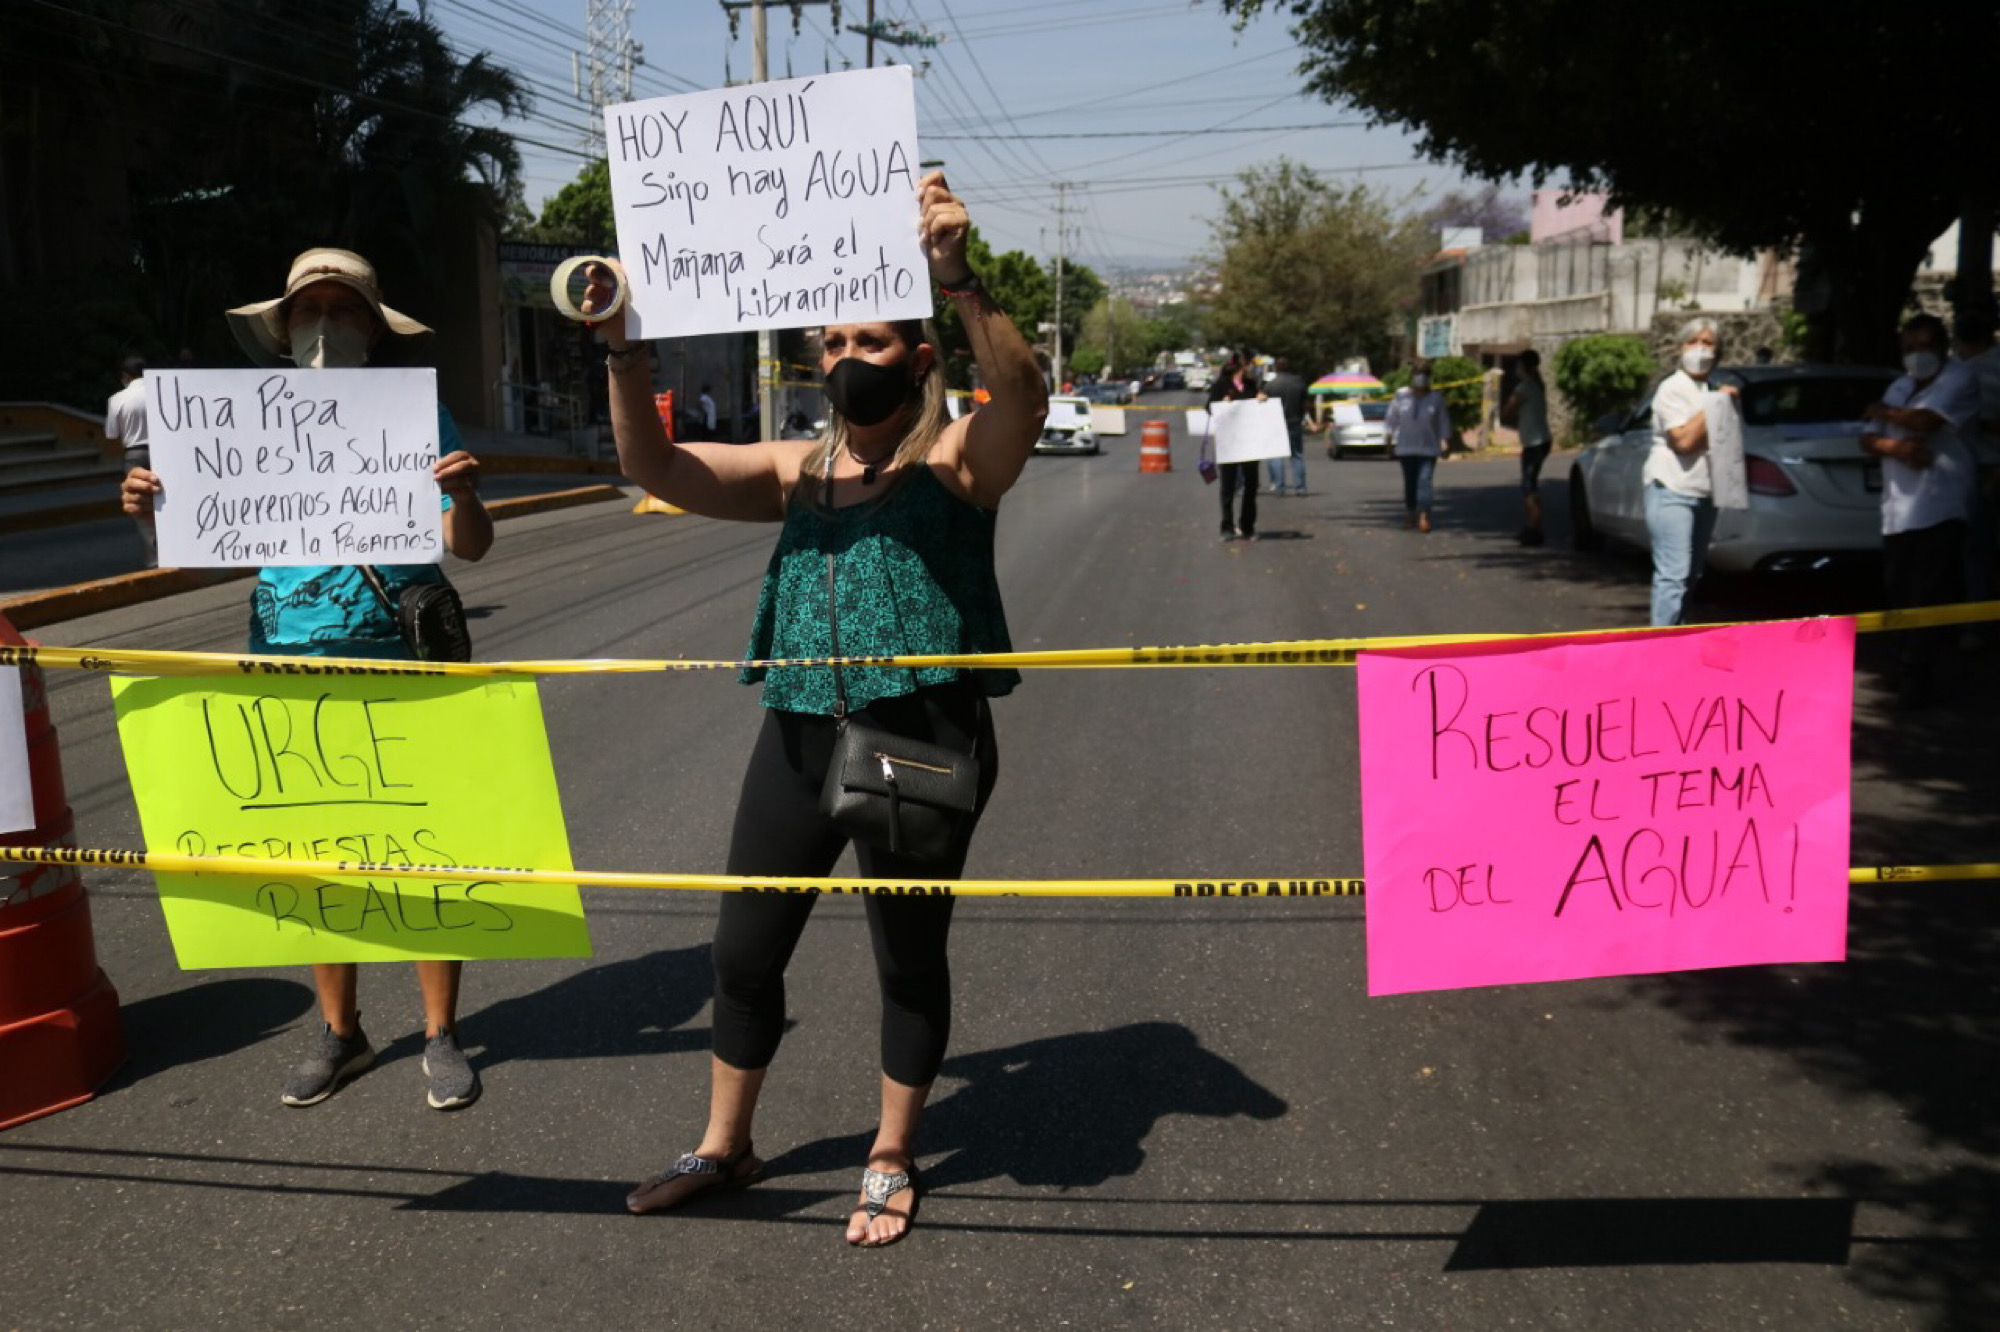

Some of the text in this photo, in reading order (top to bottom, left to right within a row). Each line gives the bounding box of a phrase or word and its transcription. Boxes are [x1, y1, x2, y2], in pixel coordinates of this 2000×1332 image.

[618, 80, 815, 162] HOY AQUÍ
[727, 164, 789, 219] hay
[805, 140, 915, 203] AGUA
[641, 215, 859, 300] Mañana Será el
[736, 245, 915, 323] Libramiento
[156, 373, 349, 453] Una Pipa
[194, 428, 438, 480] No es la Solución
[212, 529, 288, 562] Porque
[300, 527, 321, 557] la
[201, 692, 414, 801] URGE
[1412, 663, 1785, 781] RESUELVAN
[1554, 761, 1775, 826] EL TEMA
[257, 880, 516, 937] REALES
[1422, 863, 1514, 914] DEL
